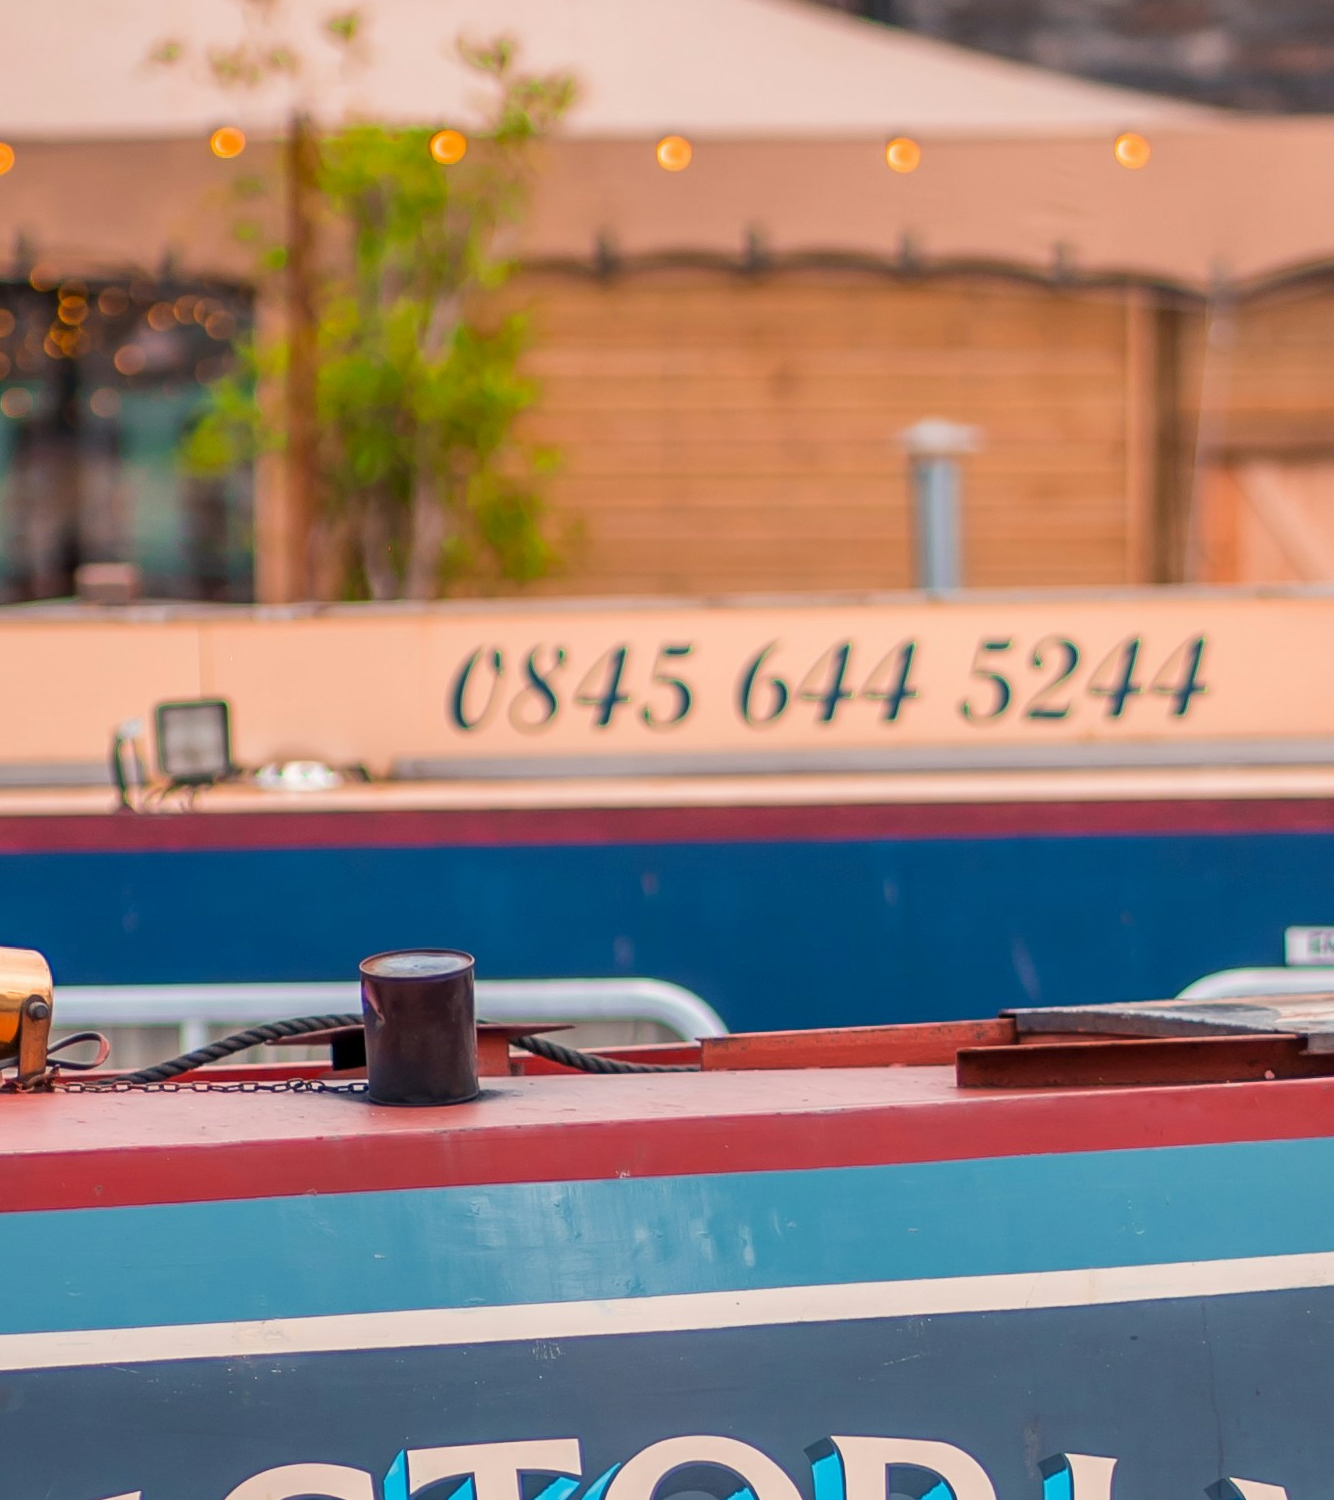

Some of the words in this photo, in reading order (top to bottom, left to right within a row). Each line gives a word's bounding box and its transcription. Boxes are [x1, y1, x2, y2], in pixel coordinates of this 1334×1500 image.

[445, 641, 695, 736] 0845
[735, 637, 921, 728] 644
[958, 633, 1210, 728] 5244
